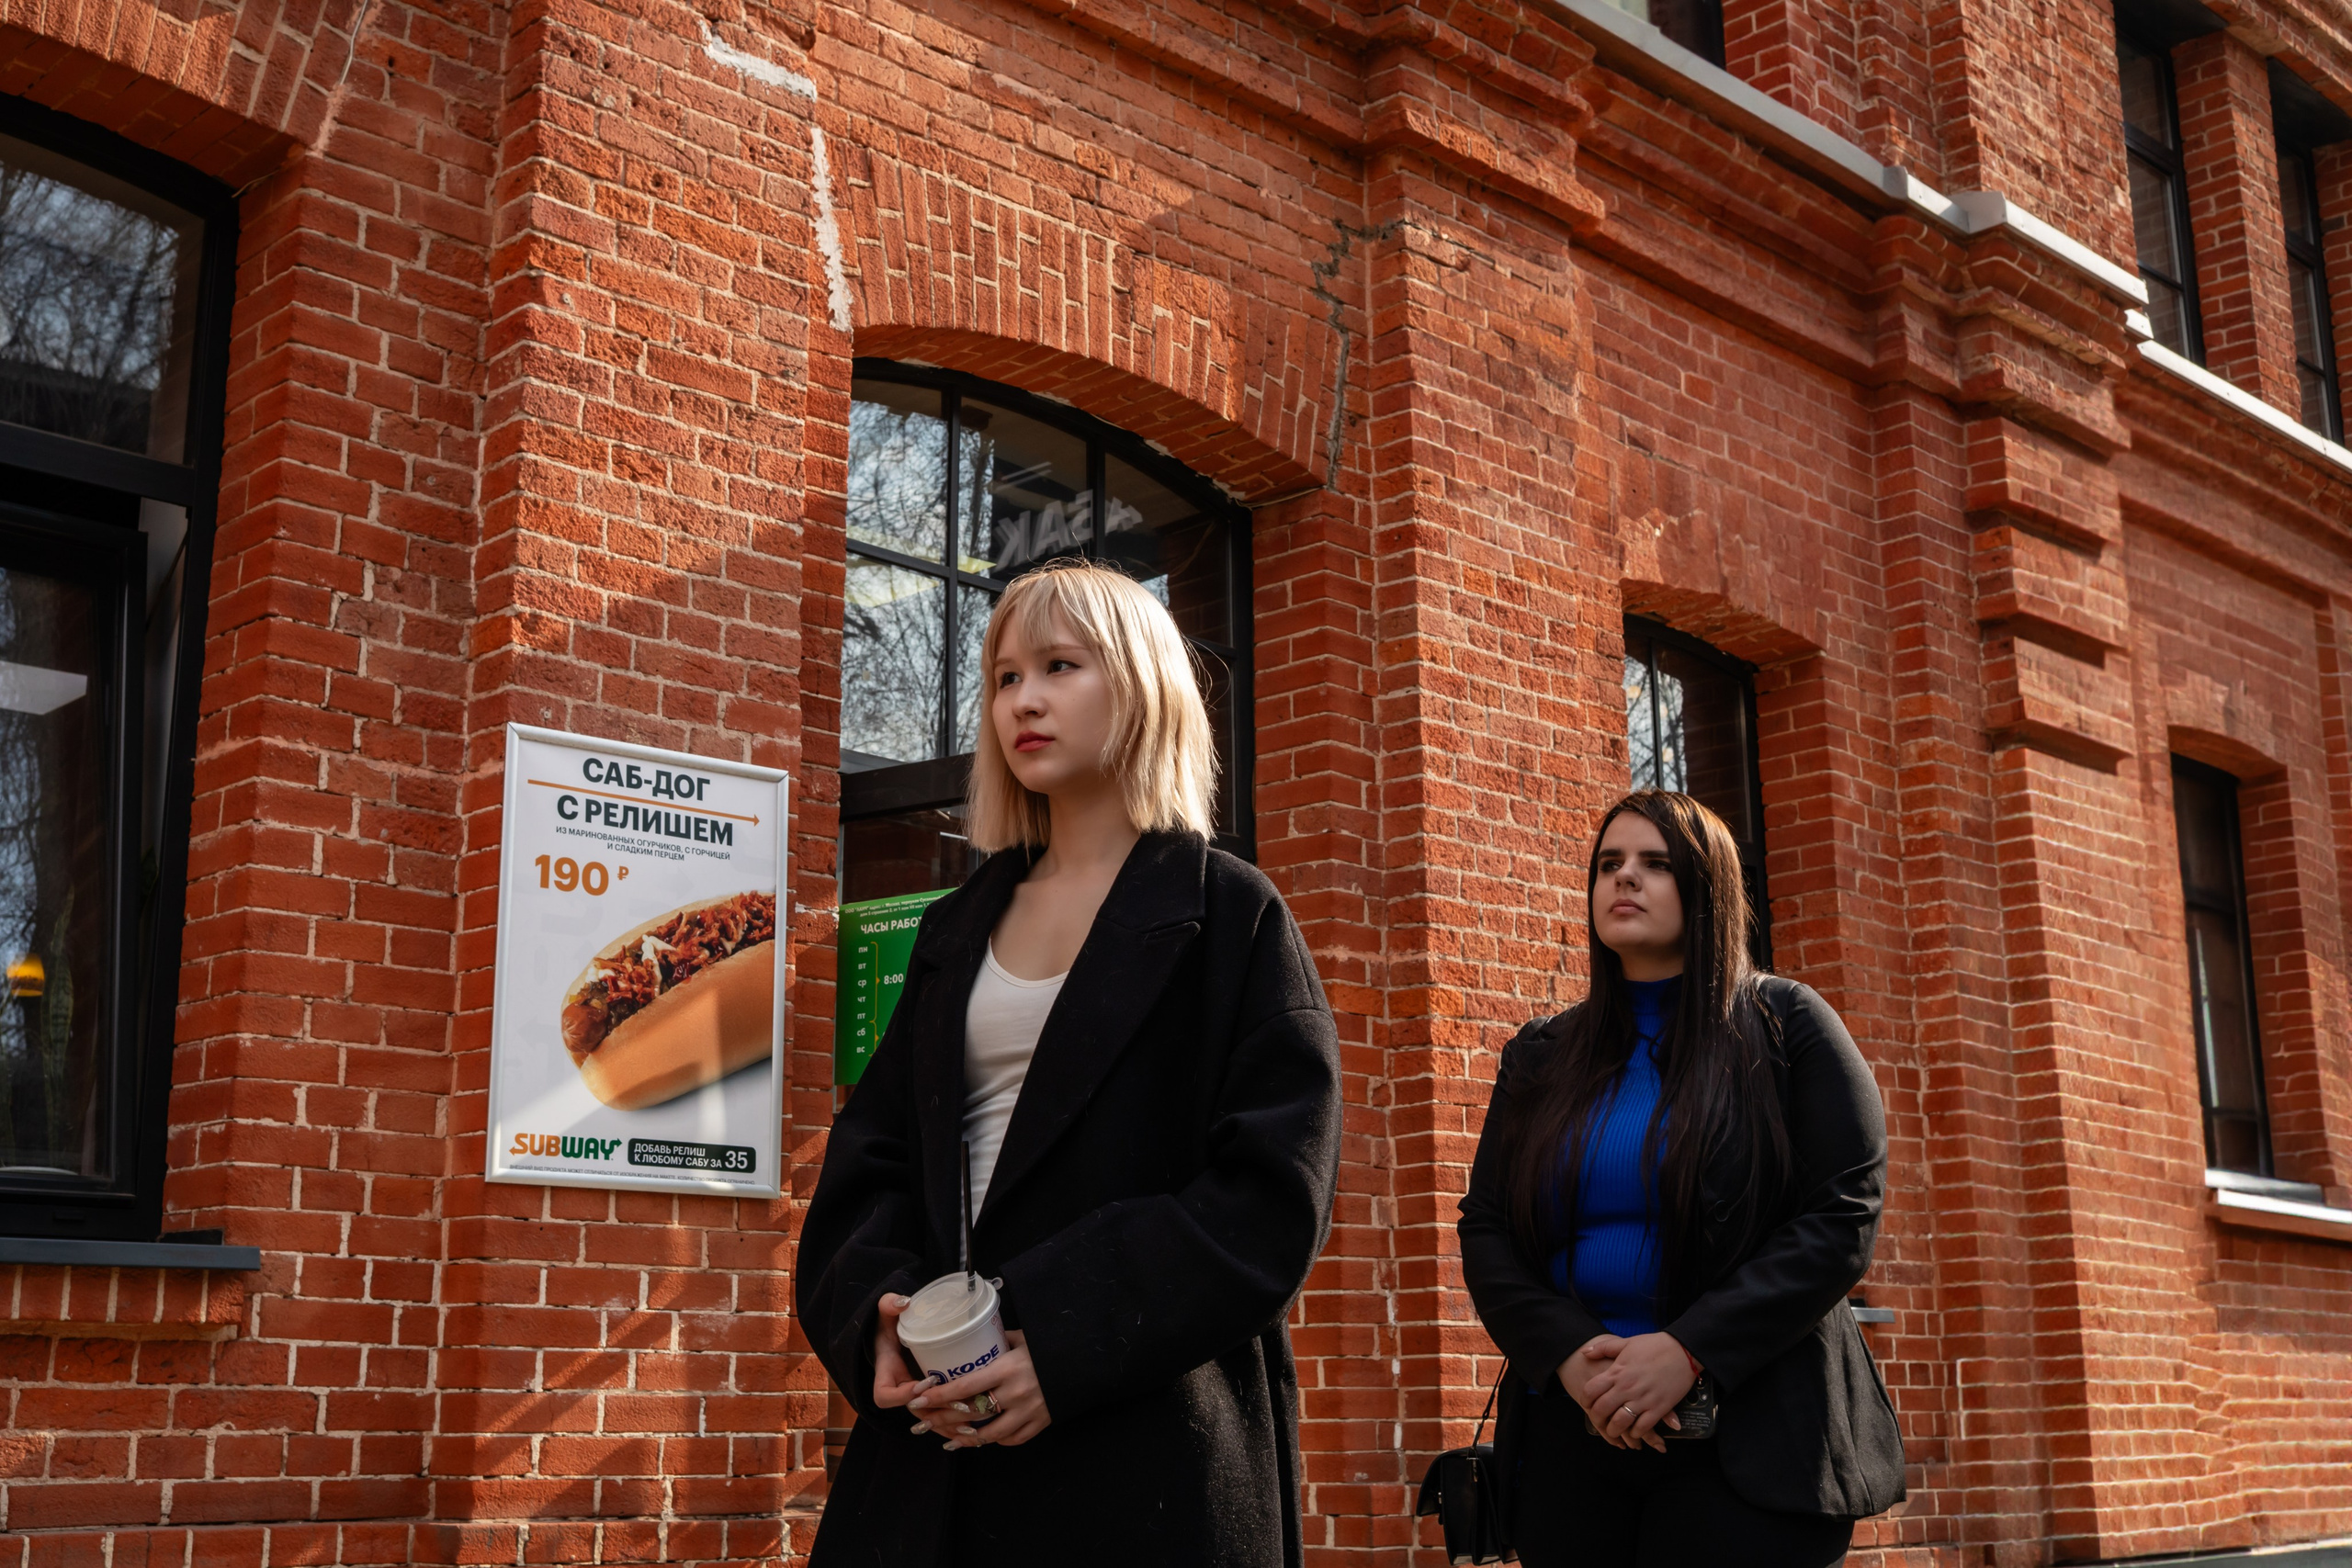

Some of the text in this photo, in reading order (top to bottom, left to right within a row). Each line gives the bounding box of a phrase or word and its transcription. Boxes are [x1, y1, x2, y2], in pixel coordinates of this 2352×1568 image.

[582, 757, 710, 801] САБ-ДОГ
[557, 795, 733, 846] С РЕЛИШЕМ
[556, 826, 567, 834] ИЗ
[569, 829, 635, 845] МАРИНОВАННЫХ
[637, 840, 683, 853] ОГУРЧИКОВ,
[692, 848, 730, 861] ГОРЧИЦЕЙ
[615, 844, 653, 856] СЛАДКИМ
[654, 850, 684, 861] ПЕРЦЕМ
[535, 854, 609, 896] 190
[861, 921, 888, 934] ЧАСЫ
[857, 979, 867, 988] ср
[884, 973, 904, 985] 8:00
[857, 1028, 865, 1036] сб
[509, 1133, 622, 1160] SUBWAY
[634, 1143, 706, 1156] ДОБАВЬ РЕЛИШ
[634, 1150, 748, 1169] К ЛЮБОМУ САБУ ЗА 35
[947, 1344, 999, 1377] КОФЕ
